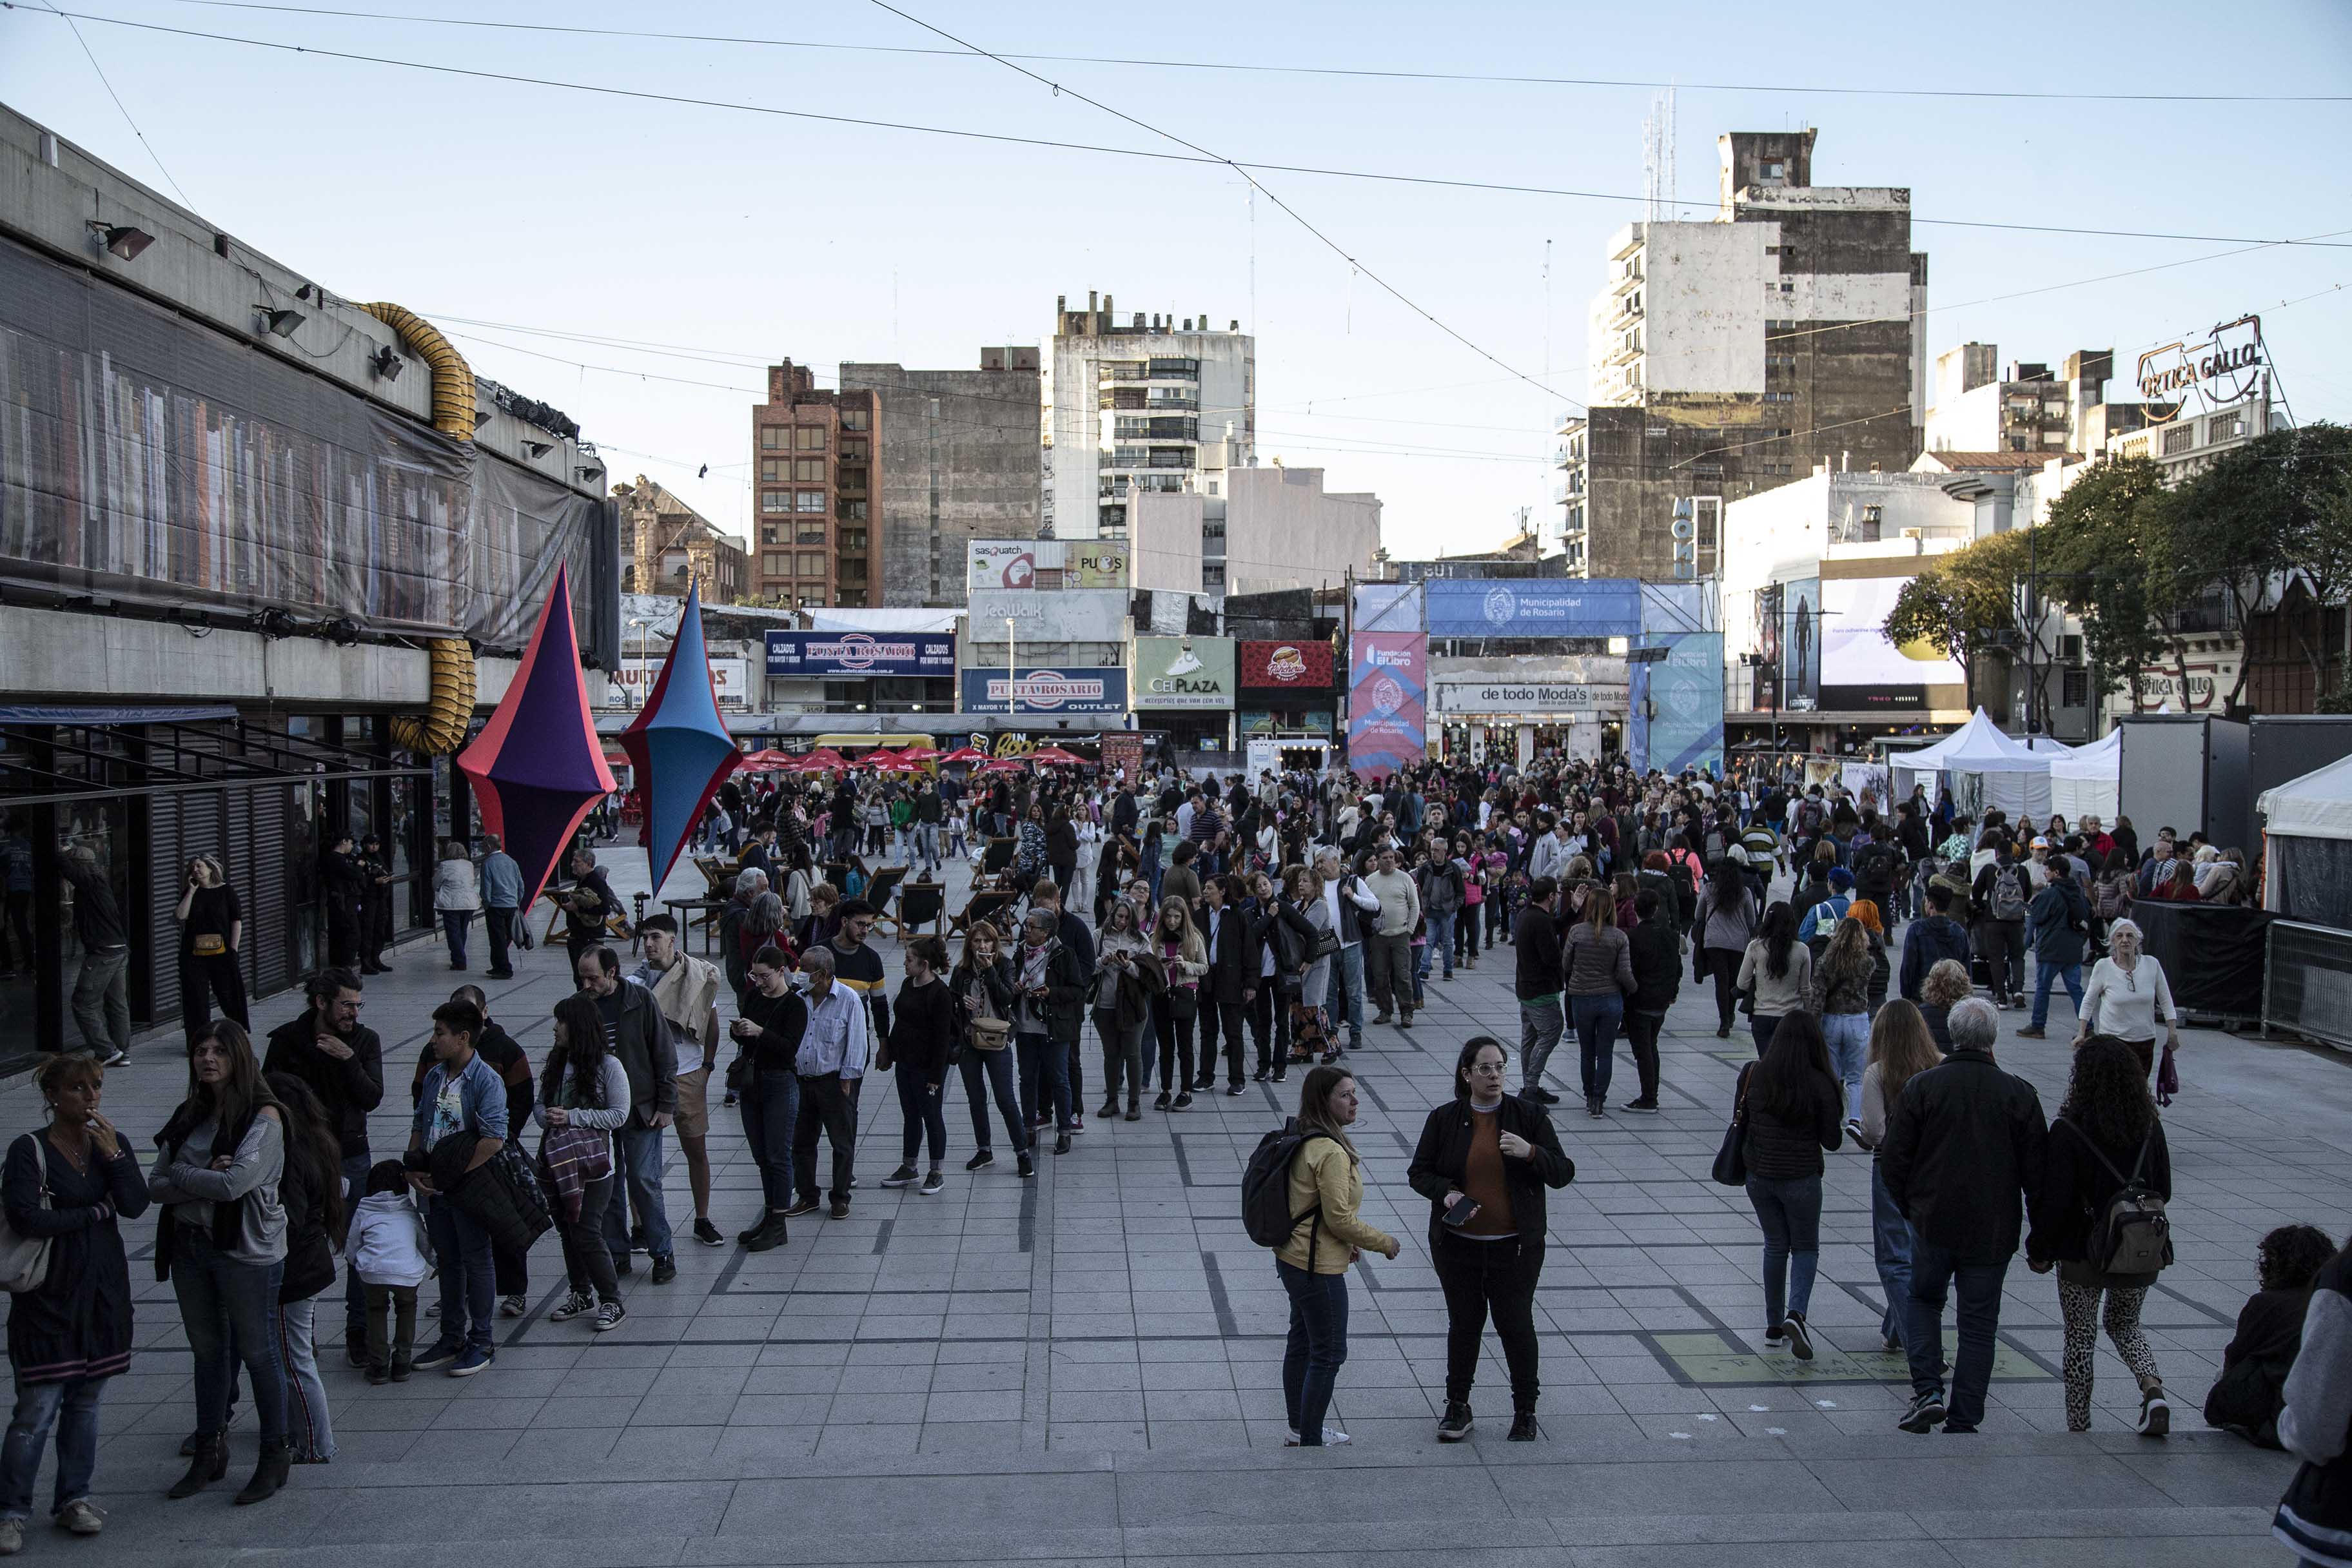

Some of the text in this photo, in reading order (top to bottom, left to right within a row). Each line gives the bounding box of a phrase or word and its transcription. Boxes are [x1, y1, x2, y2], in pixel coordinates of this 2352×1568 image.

[2200, 344, 2255, 378] GALLO
[1520, 598, 1581, 607] Municipalidad
[1520, 608, 1565, 616] de Rosario
[773, 643, 795, 654] CALZADOS
[807, 645, 916, 656] PUNTA ROSARIO
[925, 644, 948, 654] CALZADOS
[990, 685, 1102, 694] PUNTA ROSARIO
[2141, 677, 2211, 695] PTICA GLLO
[1482, 688, 1587, 700] de todo Moda's
[1592, 691, 1629, 701] de todo Moda
[1177, 697, 1186, 705] que
[1364, 719, 1409, 728] Municipalidad
